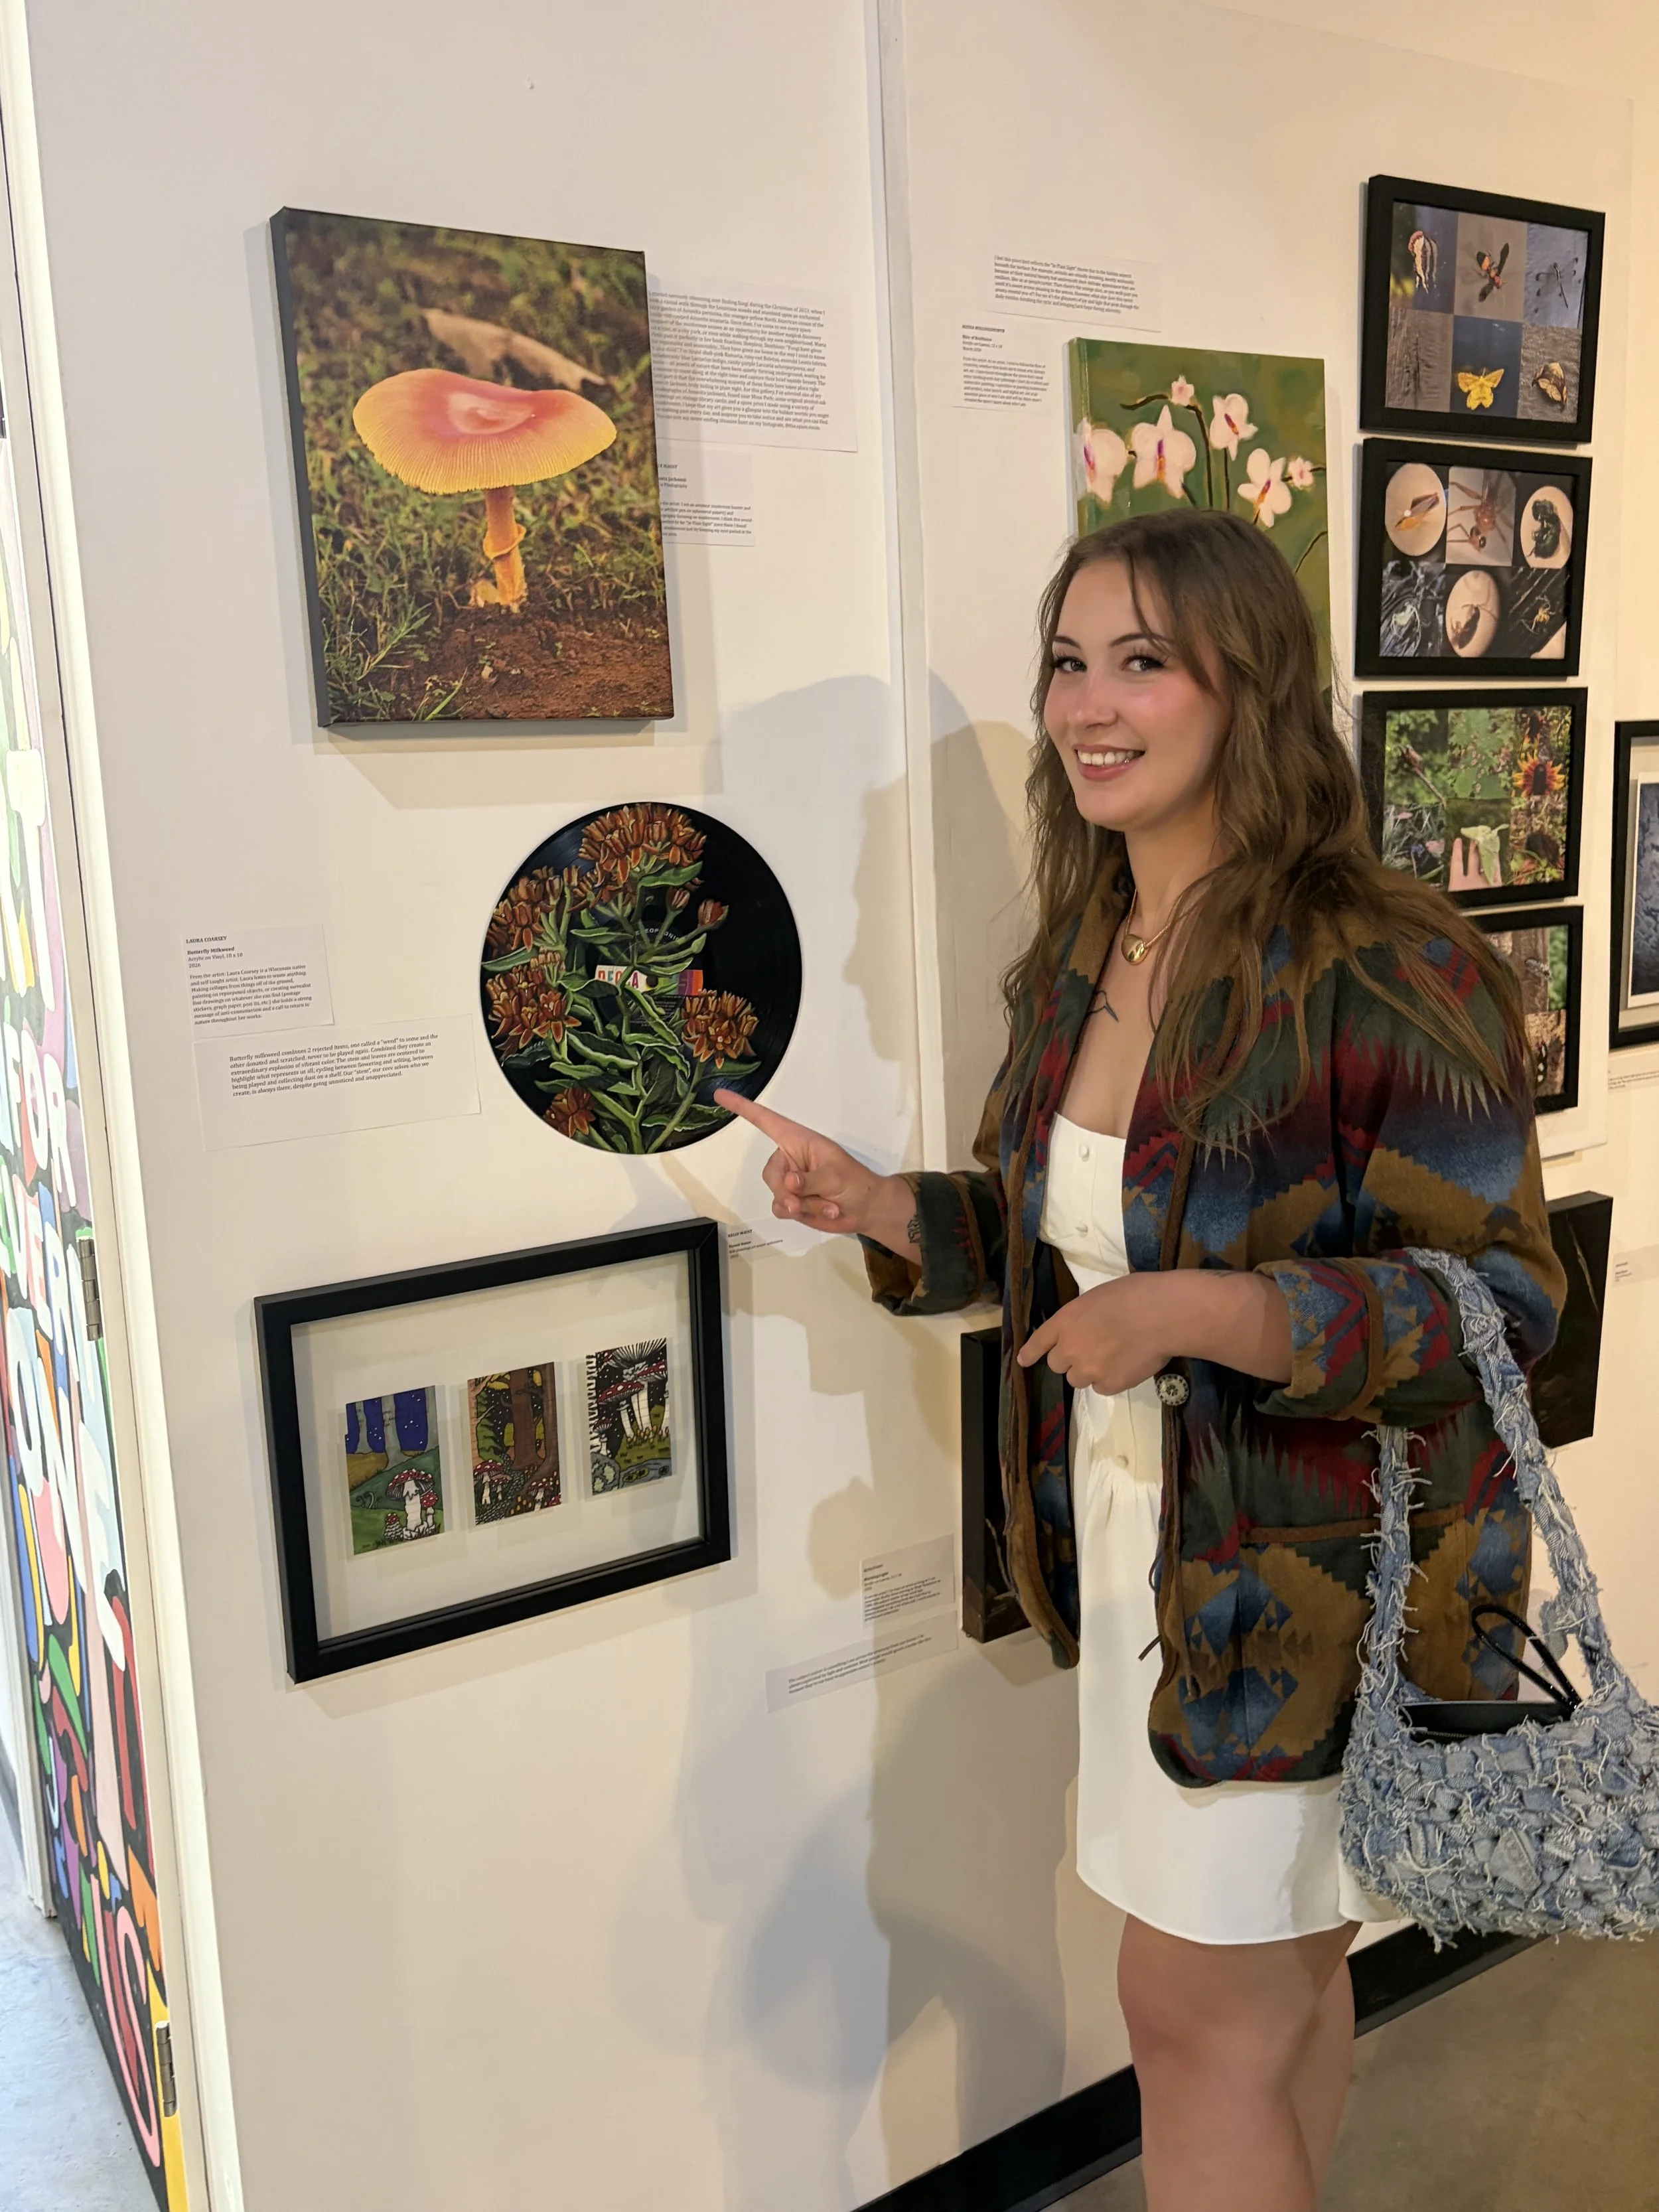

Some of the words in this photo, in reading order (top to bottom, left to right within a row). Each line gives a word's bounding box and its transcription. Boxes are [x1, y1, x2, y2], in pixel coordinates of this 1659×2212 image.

[229, 1054, 254, 1063] Butterfly
[312, 1045, 334, 1054] rejected
[337, 1049, 354, 1058] played
[231, 1066, 268, 1077] extraordinary
[231, 1074, 255, 1084] highlight
[316, 1065, 334, 1074] cycling
[357, 1059, 382, 1069] flowering
[248, 1080, 266, 1088] played
[277, 1076, 304, 1085] collecting
[257, 1086, 276, 1094] always
[293, 1081, 313, 1090] despite
[313, 1079, 328, 1088] going
[3, 1021, 77, 1208] FOR
[7, 1307, 125, 1671] ONE
